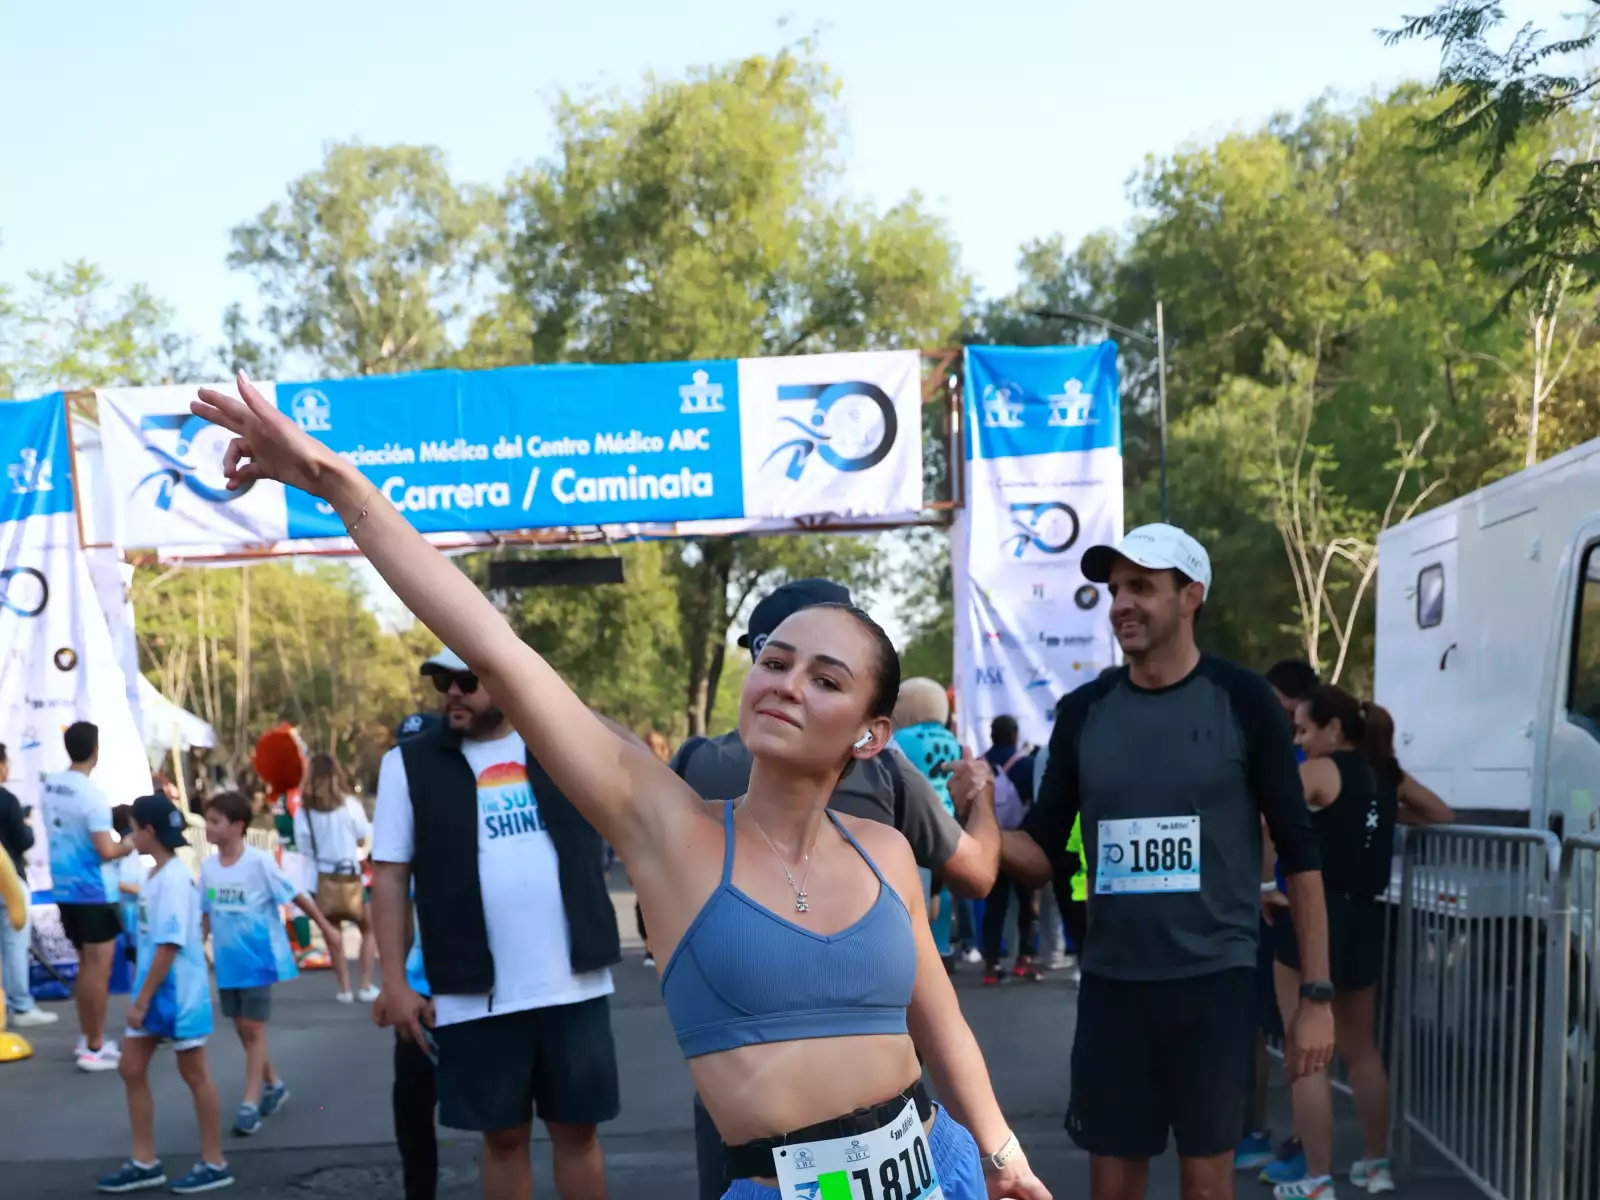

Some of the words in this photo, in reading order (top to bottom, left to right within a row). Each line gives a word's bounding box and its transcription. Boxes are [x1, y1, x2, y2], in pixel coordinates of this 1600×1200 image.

[492, 434, 523, 460] del
[526, 435, 591, 458] Centro
[594, 429, 664, 455] Médico
[668, 427, 710, 452] ABC
[381, 475, 511, 512] Carrera
[550, 464, 713, 504] Caminata
[1129, 837, 1192, 873] 1686
